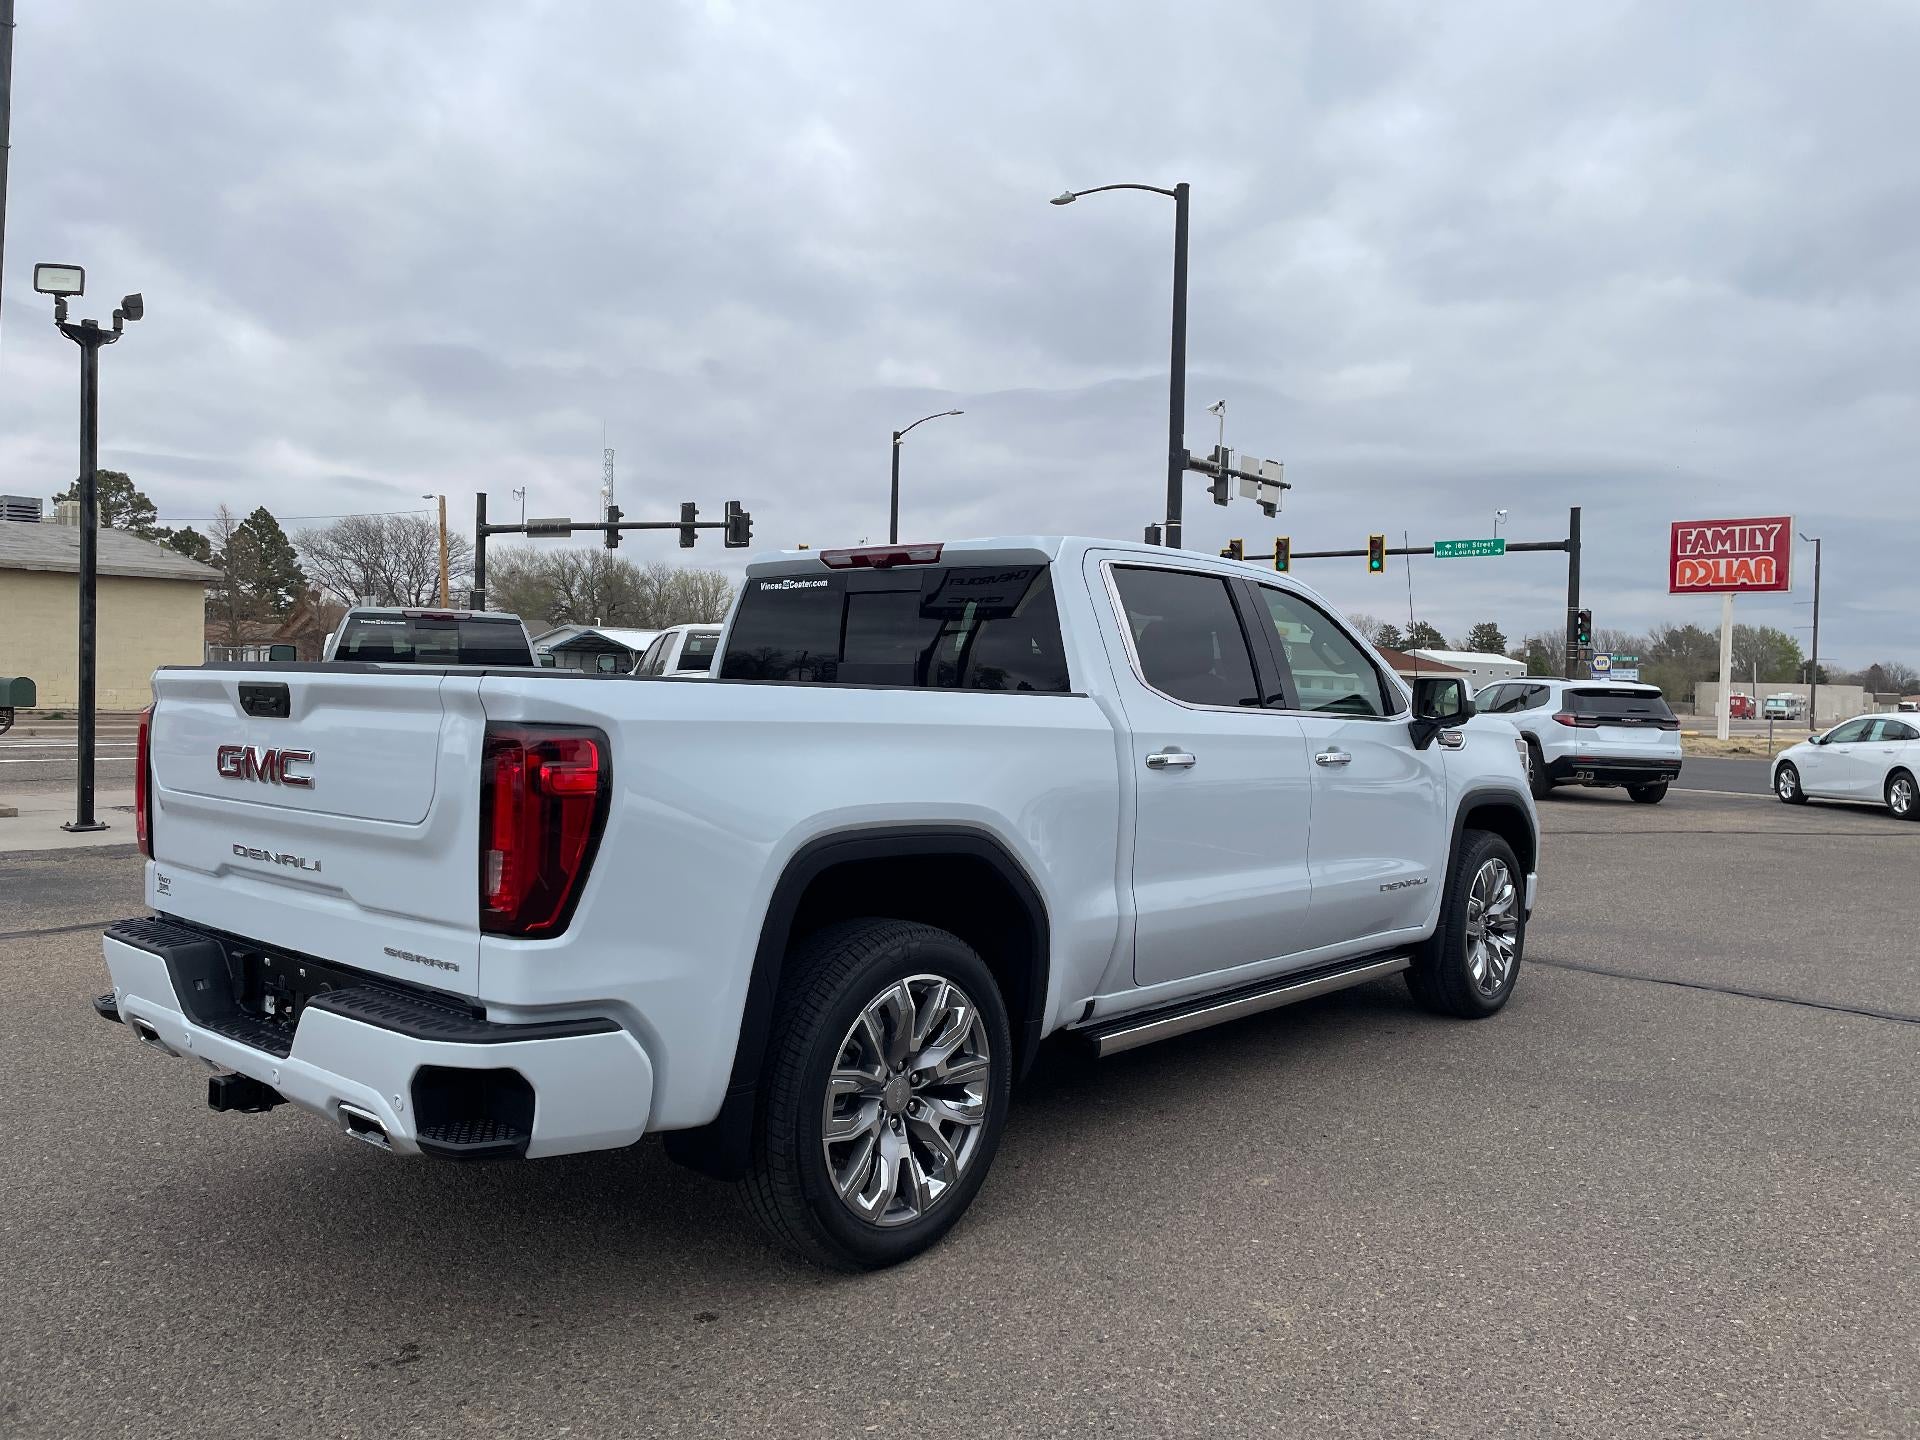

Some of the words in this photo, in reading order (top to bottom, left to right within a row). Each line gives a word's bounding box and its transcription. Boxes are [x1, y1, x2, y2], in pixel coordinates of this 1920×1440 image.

[1677, 524, 1782, 555] FAMILY
[1676, 556, 1776, 587] DOLLAR
[217, 745, 316, 790] GMC
[232, 843, 322, 872] DENALI
[1380, 877, 1428, 892] DENALI
[383, 946, 460, 972] SIERRA
